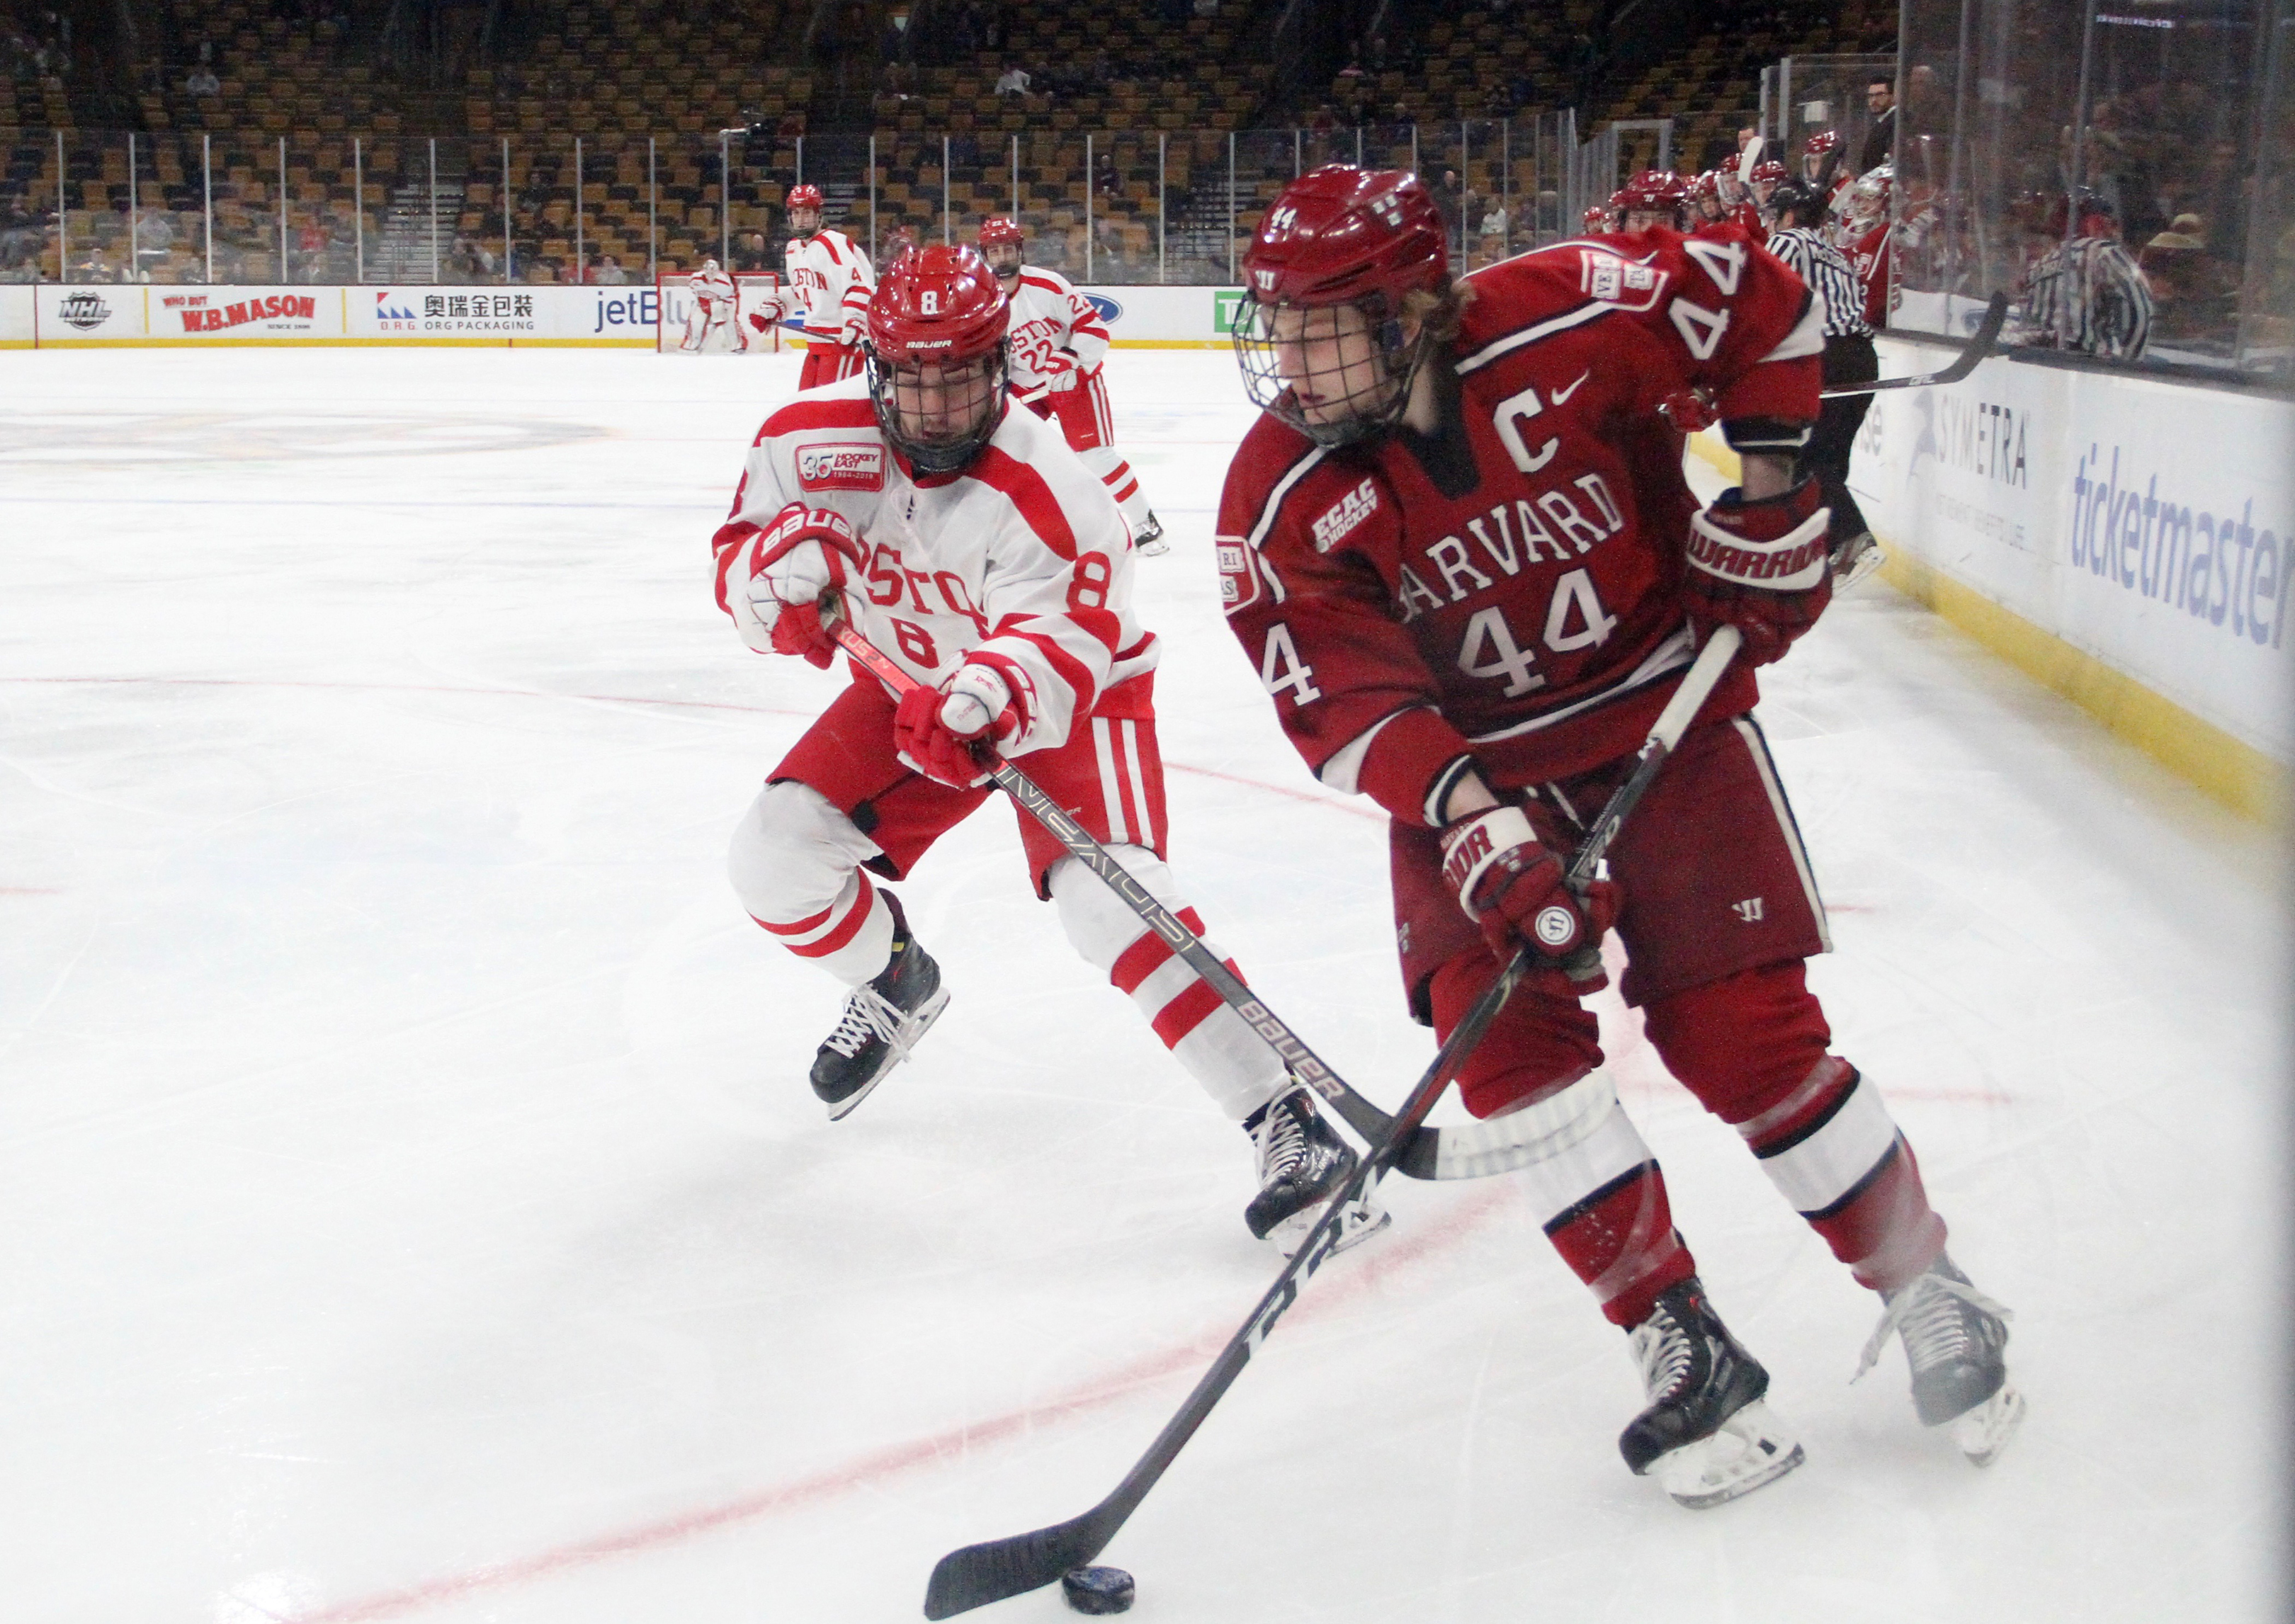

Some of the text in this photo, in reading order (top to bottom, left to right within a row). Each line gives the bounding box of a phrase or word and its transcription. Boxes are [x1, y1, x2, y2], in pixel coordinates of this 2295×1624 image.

[1271, 206, 1297, 229] 44
[851, 267, 862, 282] 4
[59, 300, 112, 317] NHL
[162, 295, 208, 307] WHO BUT
[425, 295, 533, 317] 奥瑞金包装
[595, 290, 697, 333] jetBlu
[921, 290, 938, 315] 8
[425, 321, 535, 331] ORG PACKAGING
[906, 340, 953, 348] BAUER
[1493, 388, 1558, 473] C
[1940, 393, 2027, 489] SYMETRA
[833, 460, 860, 468] EAST
[835, 453, 878, 462] HOCKEY
[1312, 477, 1375, 540] ECAC
[1328, 495, 1378, 546] HOCKEY
[2071, 442, 2295, 650] ticketmaster
[1065, 551, 1112, 613] 8
[1458, 568, 1618, 698] 44
[1262, 623, 1321, 706] 4
[996, 766, 1196, 952] NEXUS
[1237, 1000, 1346, 1101] BAUER
